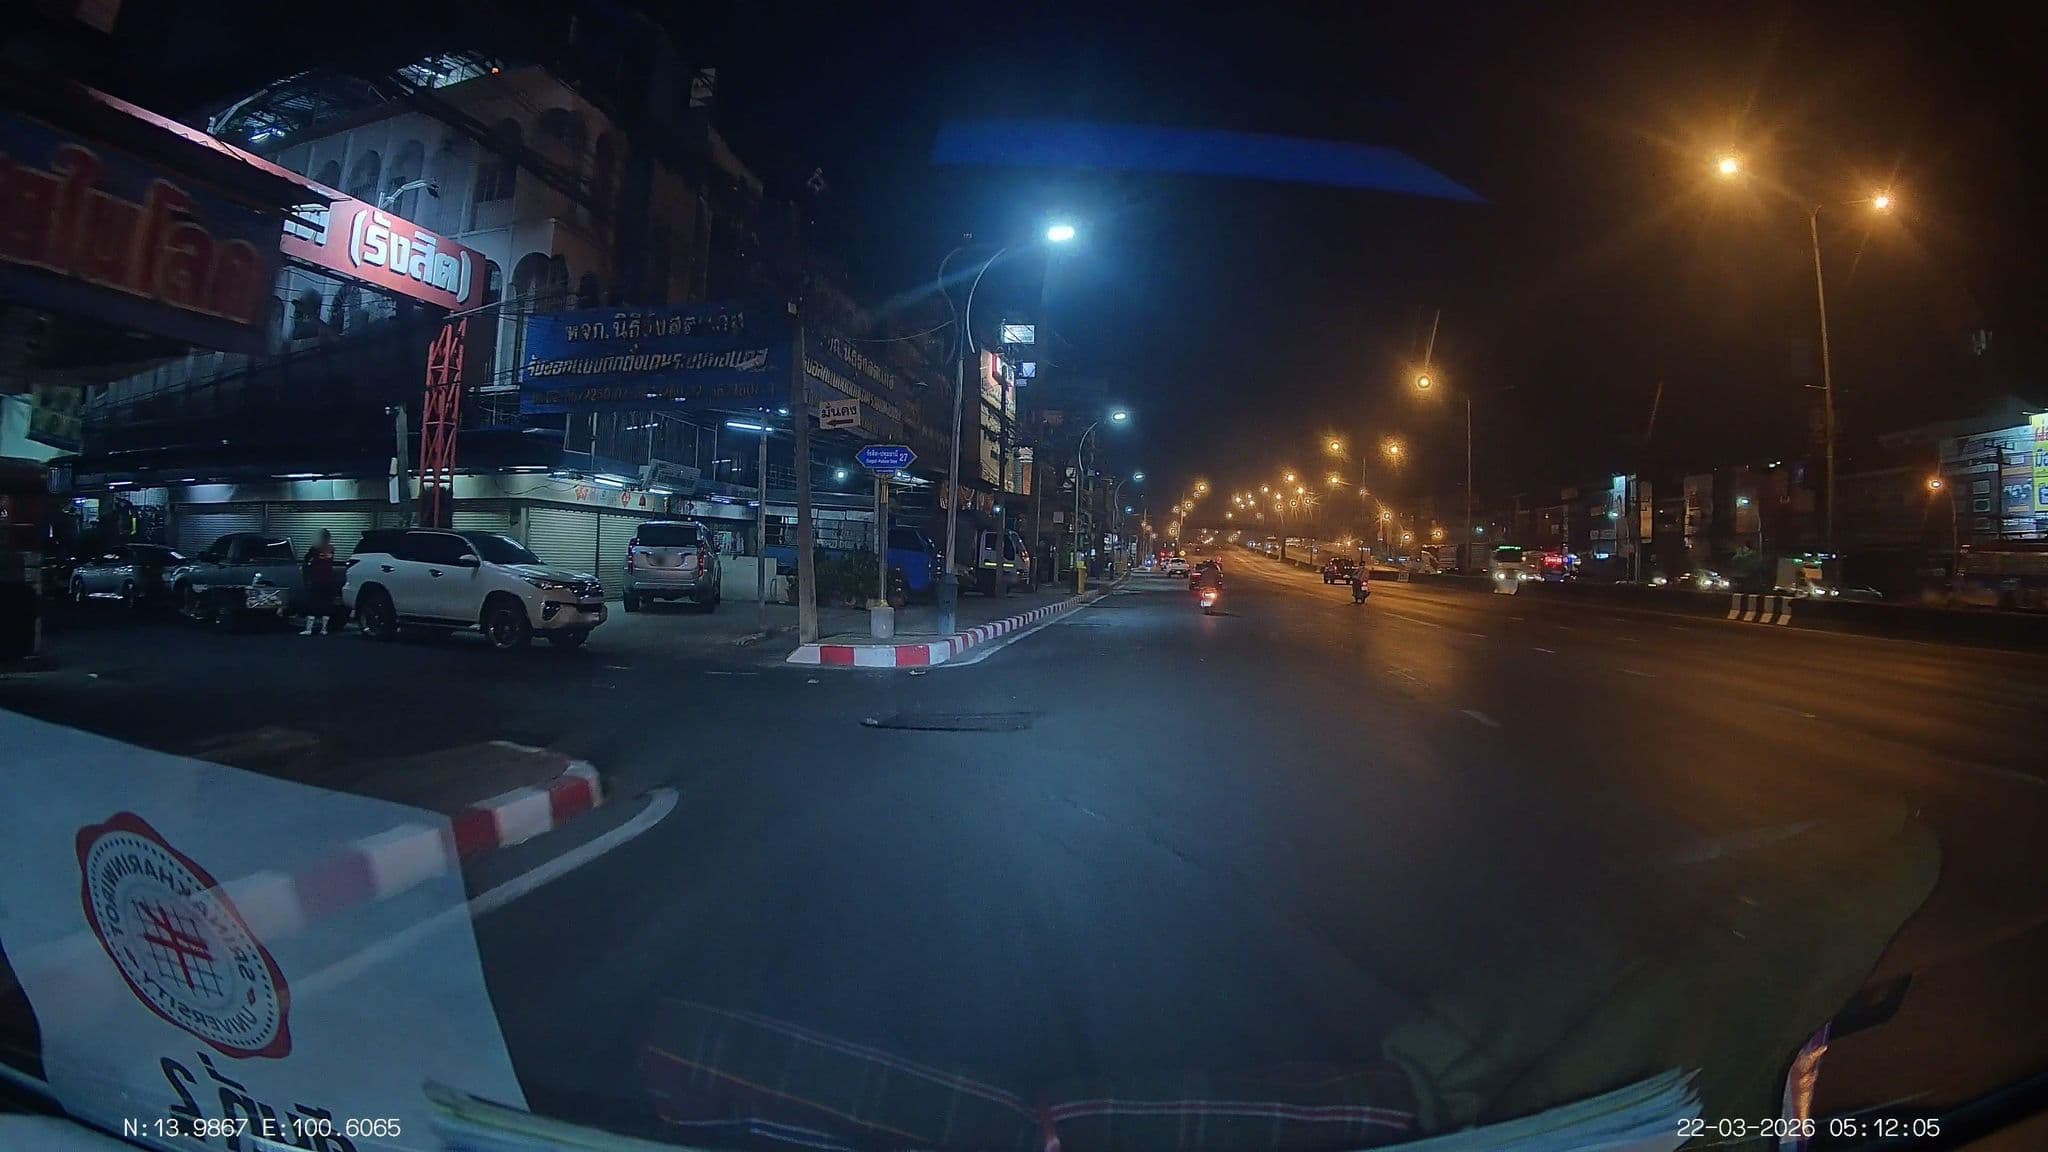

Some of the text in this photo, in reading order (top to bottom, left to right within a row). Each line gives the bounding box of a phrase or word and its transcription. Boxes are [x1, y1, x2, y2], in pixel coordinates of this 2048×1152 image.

[349, 210, 472, 304] (รังสิต)
[821, 402, 857, 418] มั่นคง
[899, 453, 908, 462] 27
